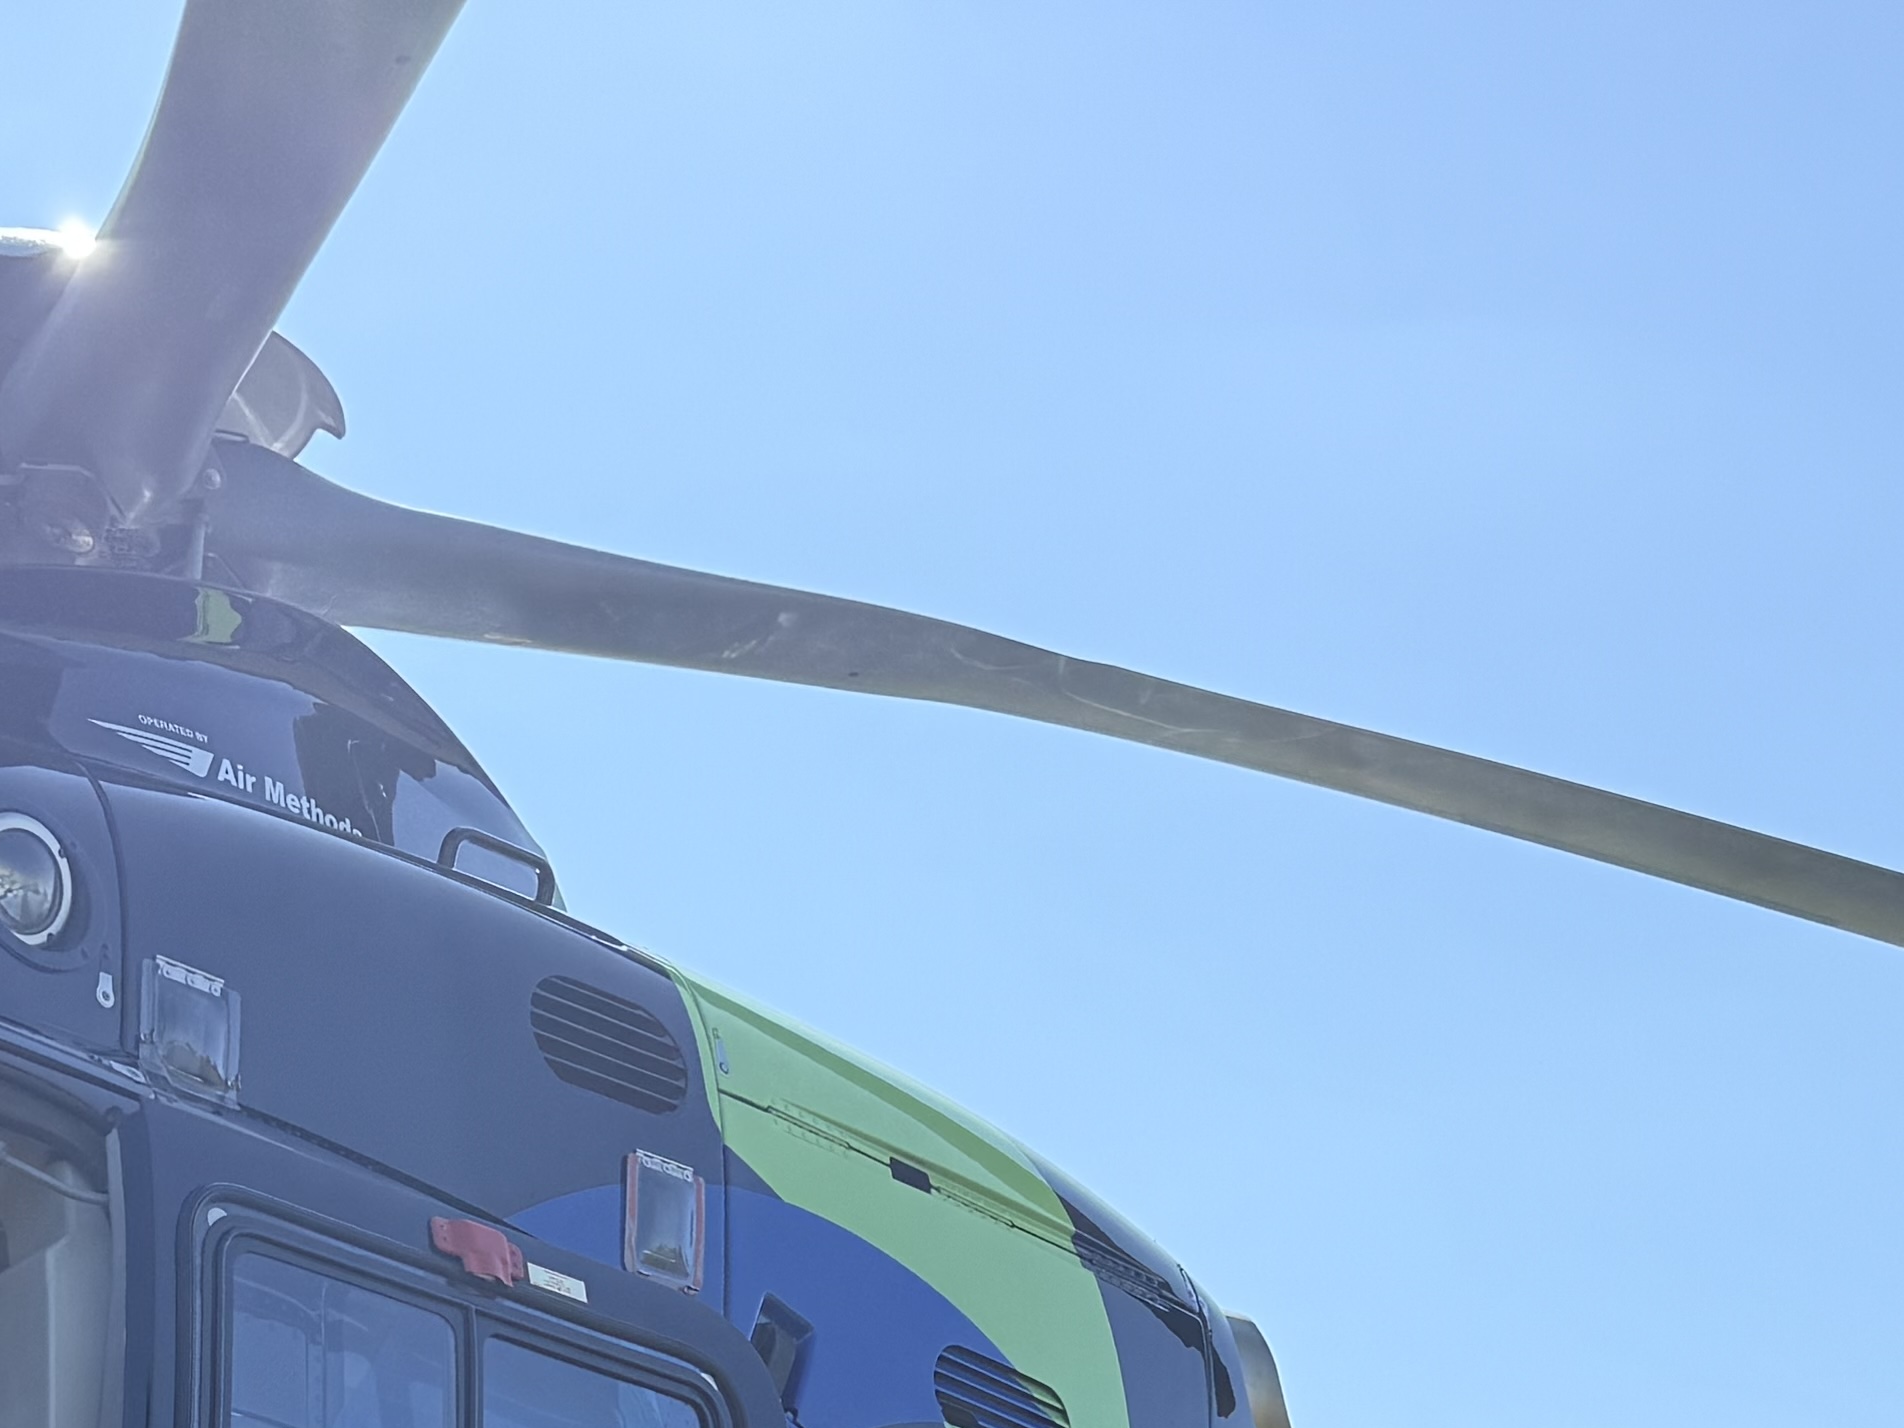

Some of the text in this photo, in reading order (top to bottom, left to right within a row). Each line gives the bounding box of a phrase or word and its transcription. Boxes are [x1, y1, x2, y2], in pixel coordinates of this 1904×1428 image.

[137, 714, 209, 744] OPERATED BY
[217, 758, 258, 793] Air
